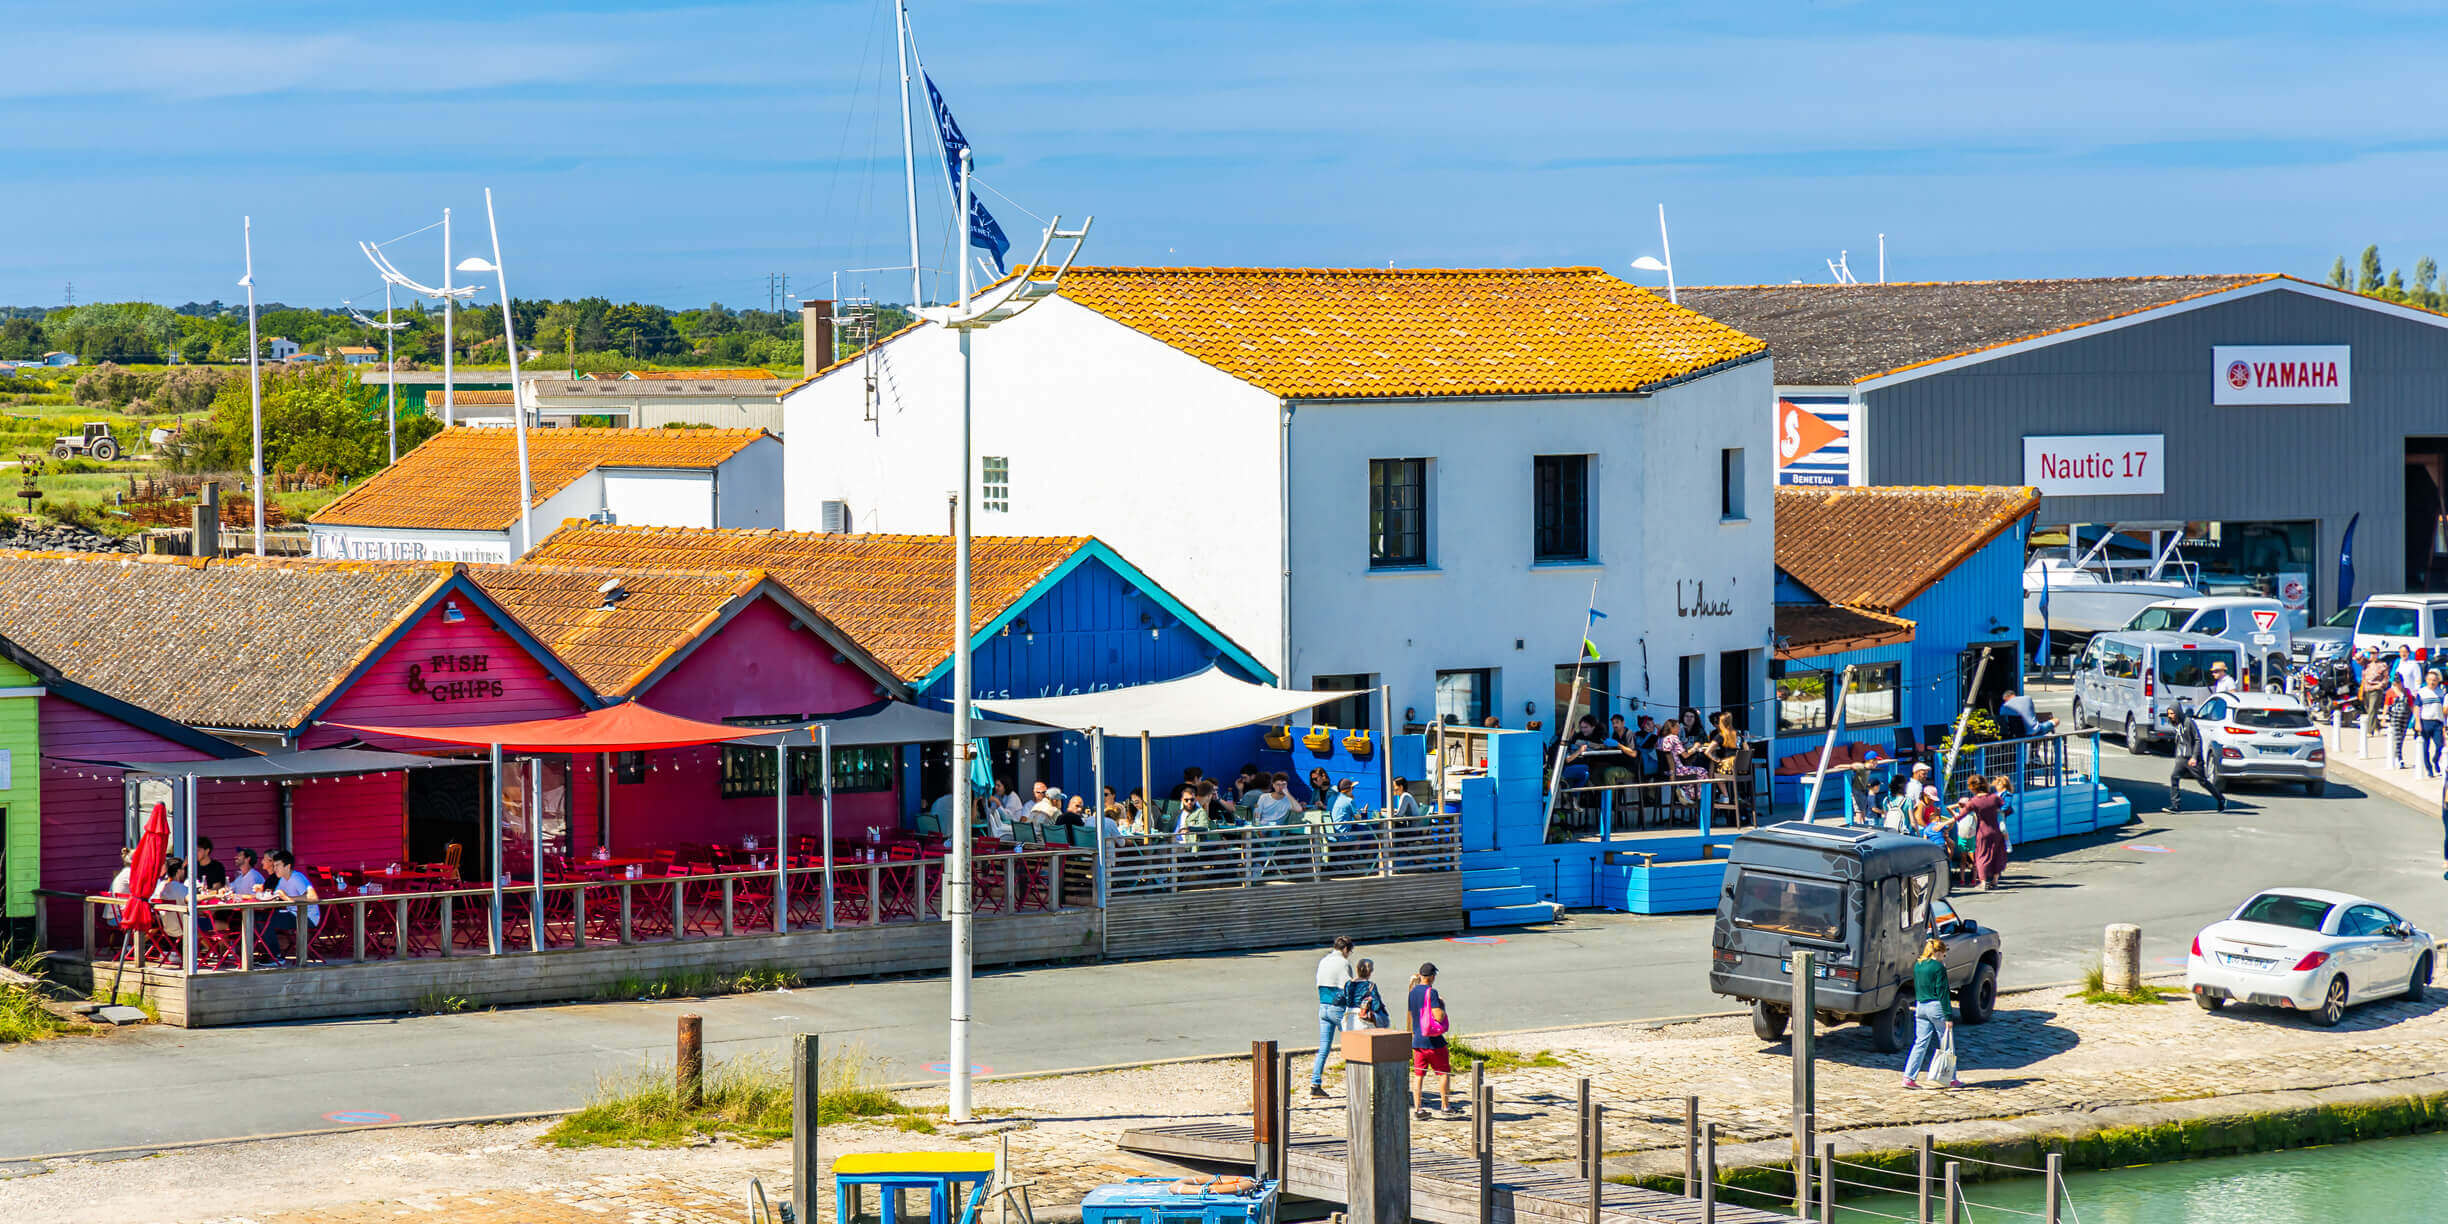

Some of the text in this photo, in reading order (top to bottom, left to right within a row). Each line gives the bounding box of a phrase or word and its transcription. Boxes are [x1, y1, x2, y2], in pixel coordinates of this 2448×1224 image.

[2253, 362, 2339, 388] YAMAHA
[2041, 451, 2147, 479] Nautic 17
[431, 655, 489, 673] FISH
[408, 664, 504, 702] & CHIPS
